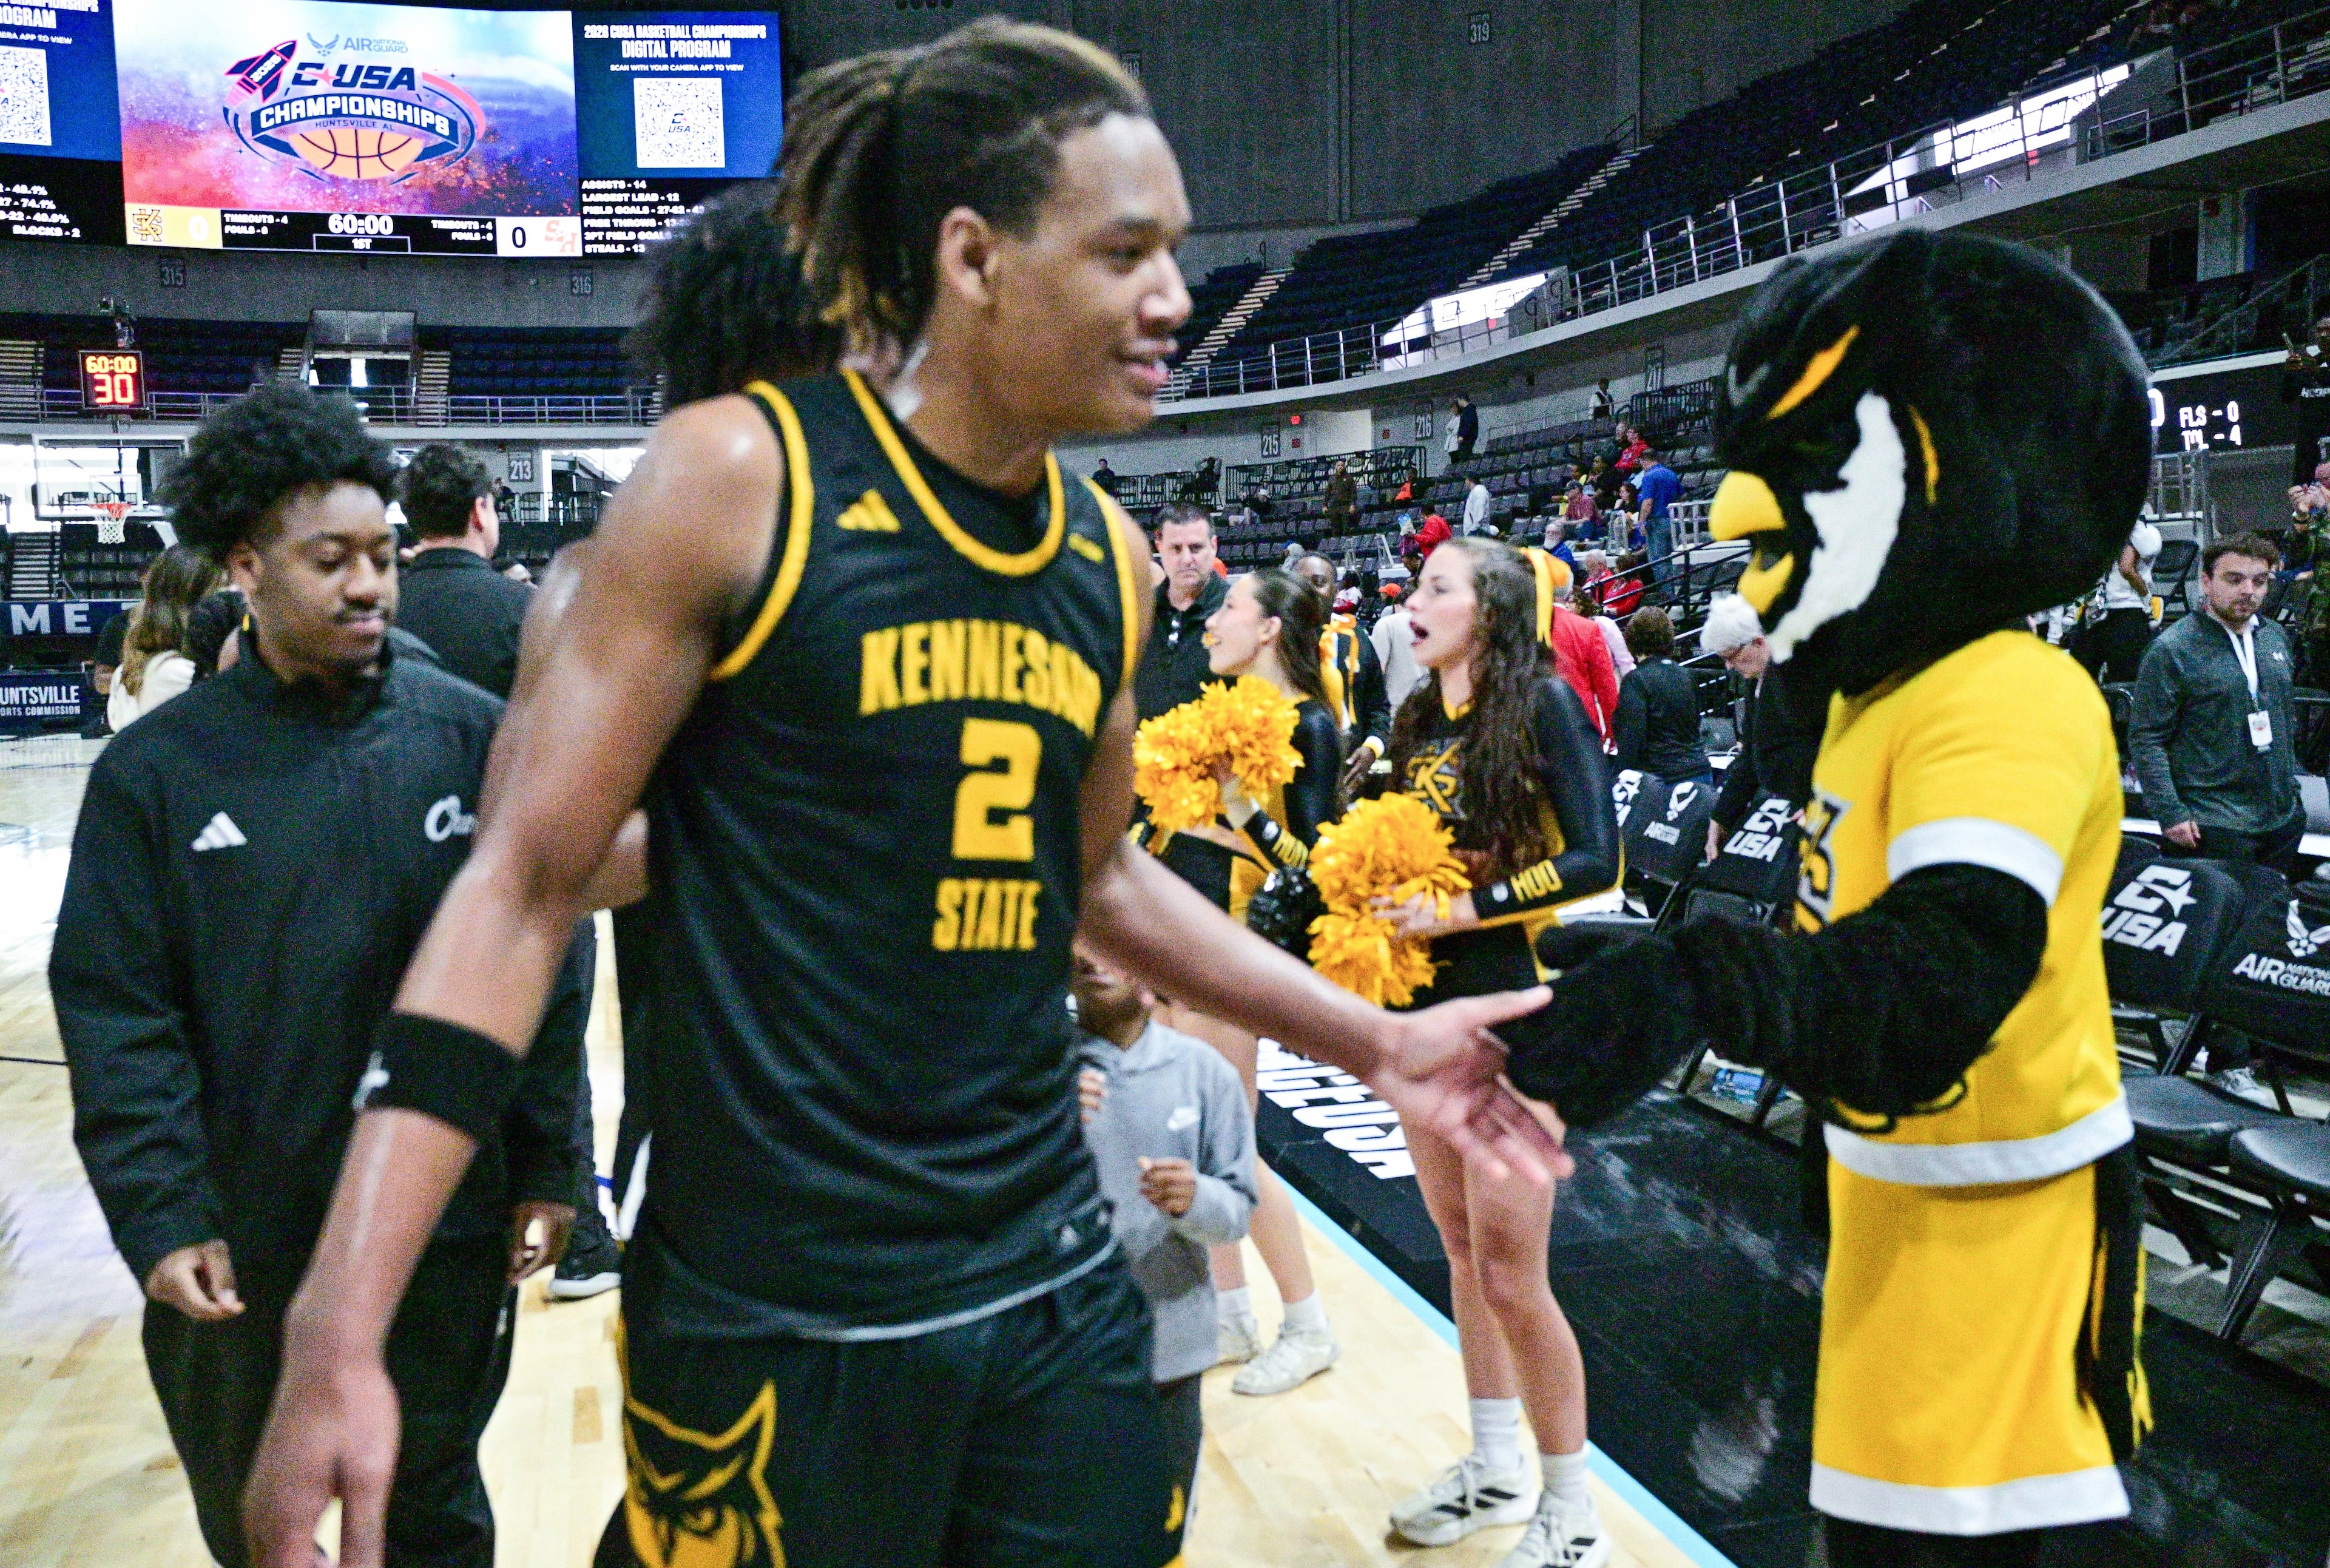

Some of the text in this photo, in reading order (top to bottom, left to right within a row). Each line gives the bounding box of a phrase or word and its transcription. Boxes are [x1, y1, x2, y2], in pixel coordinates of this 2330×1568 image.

[0, 5, 56, 29] OGRAM
[19, 32, 36, 41] APP
[50, 35, 73, 44] VIEW
[610, 25, 635, 39] CUSA
[636, 25, 692, 39] BASKETBALL
[692, 25, 766, 39] CHAMPIONSHIPS
[1470, 22, 1490, 44] 319
[344, 37, 371, 51] AIR
[374, 45, 408, 53] GUARD
[621, 40, 731, 58] DIGITAL PROGRAM
[260, 96, 450, 137] CHAMPIONSHIPS
[316, 120, 378, 128] HUNTSVILLE
[581, 180, 626, 189] ASSISTS
[633, 180, 647, 189] 14
[582, 193, 630, 202] LARGEST
[631, 193, 659, 202] LEAD
[666, 193, 680, 202] 12
[224, 214, 274, 223] TIMEOUTS
[281, 215, 288, 224] 4
[582, 206, 613, 215] FIELD
[614, 206, 650, 215] GOALS
[12, 225, 63, 237] BLOCKS
[71, 228, 81, 238] 2
[189, 215, 209, 241] 0
[225, 225, 255, 234] FOULS
[328, 214, 393, 235] 60:00
[431, 220, 479, 229] TIMEOUTS
[485, 221, 493, 230] 4
[583, 218, 610, 228] FREE
[612, 218, 656, 228] THROWS
[451, 232, 481, 241] FOULS
[512, 226, 526, 248] 0
[584, 231, 604, 240] 3PT
[606, 231, 636, 240] FIELD
[584, 244, 624, 253] STEALS
[632, 244, 645, 252] 13
[86, 356, 137, 374] 60:00
[93, 374, 134, 404] 30
[2179, 405, 2207, 428] FLS
[2227, 400, 2239, 422] 0
[1416, 414, 1432, 438] 216
[2229, 424, 2241, 445] 4
[1262, 434, 1279, 455] 215
[510, 459, 532, 480] 213
[25, 705, 80, 716] COMMISSION
[951, 717, 1042, 862] 2
[1723, 830, 1783, 862] USA
[931, 877, 1040, 951] STATE
[2100, 907, 2187, 958] USA
[2233, 953, 2286, 985] AIR
